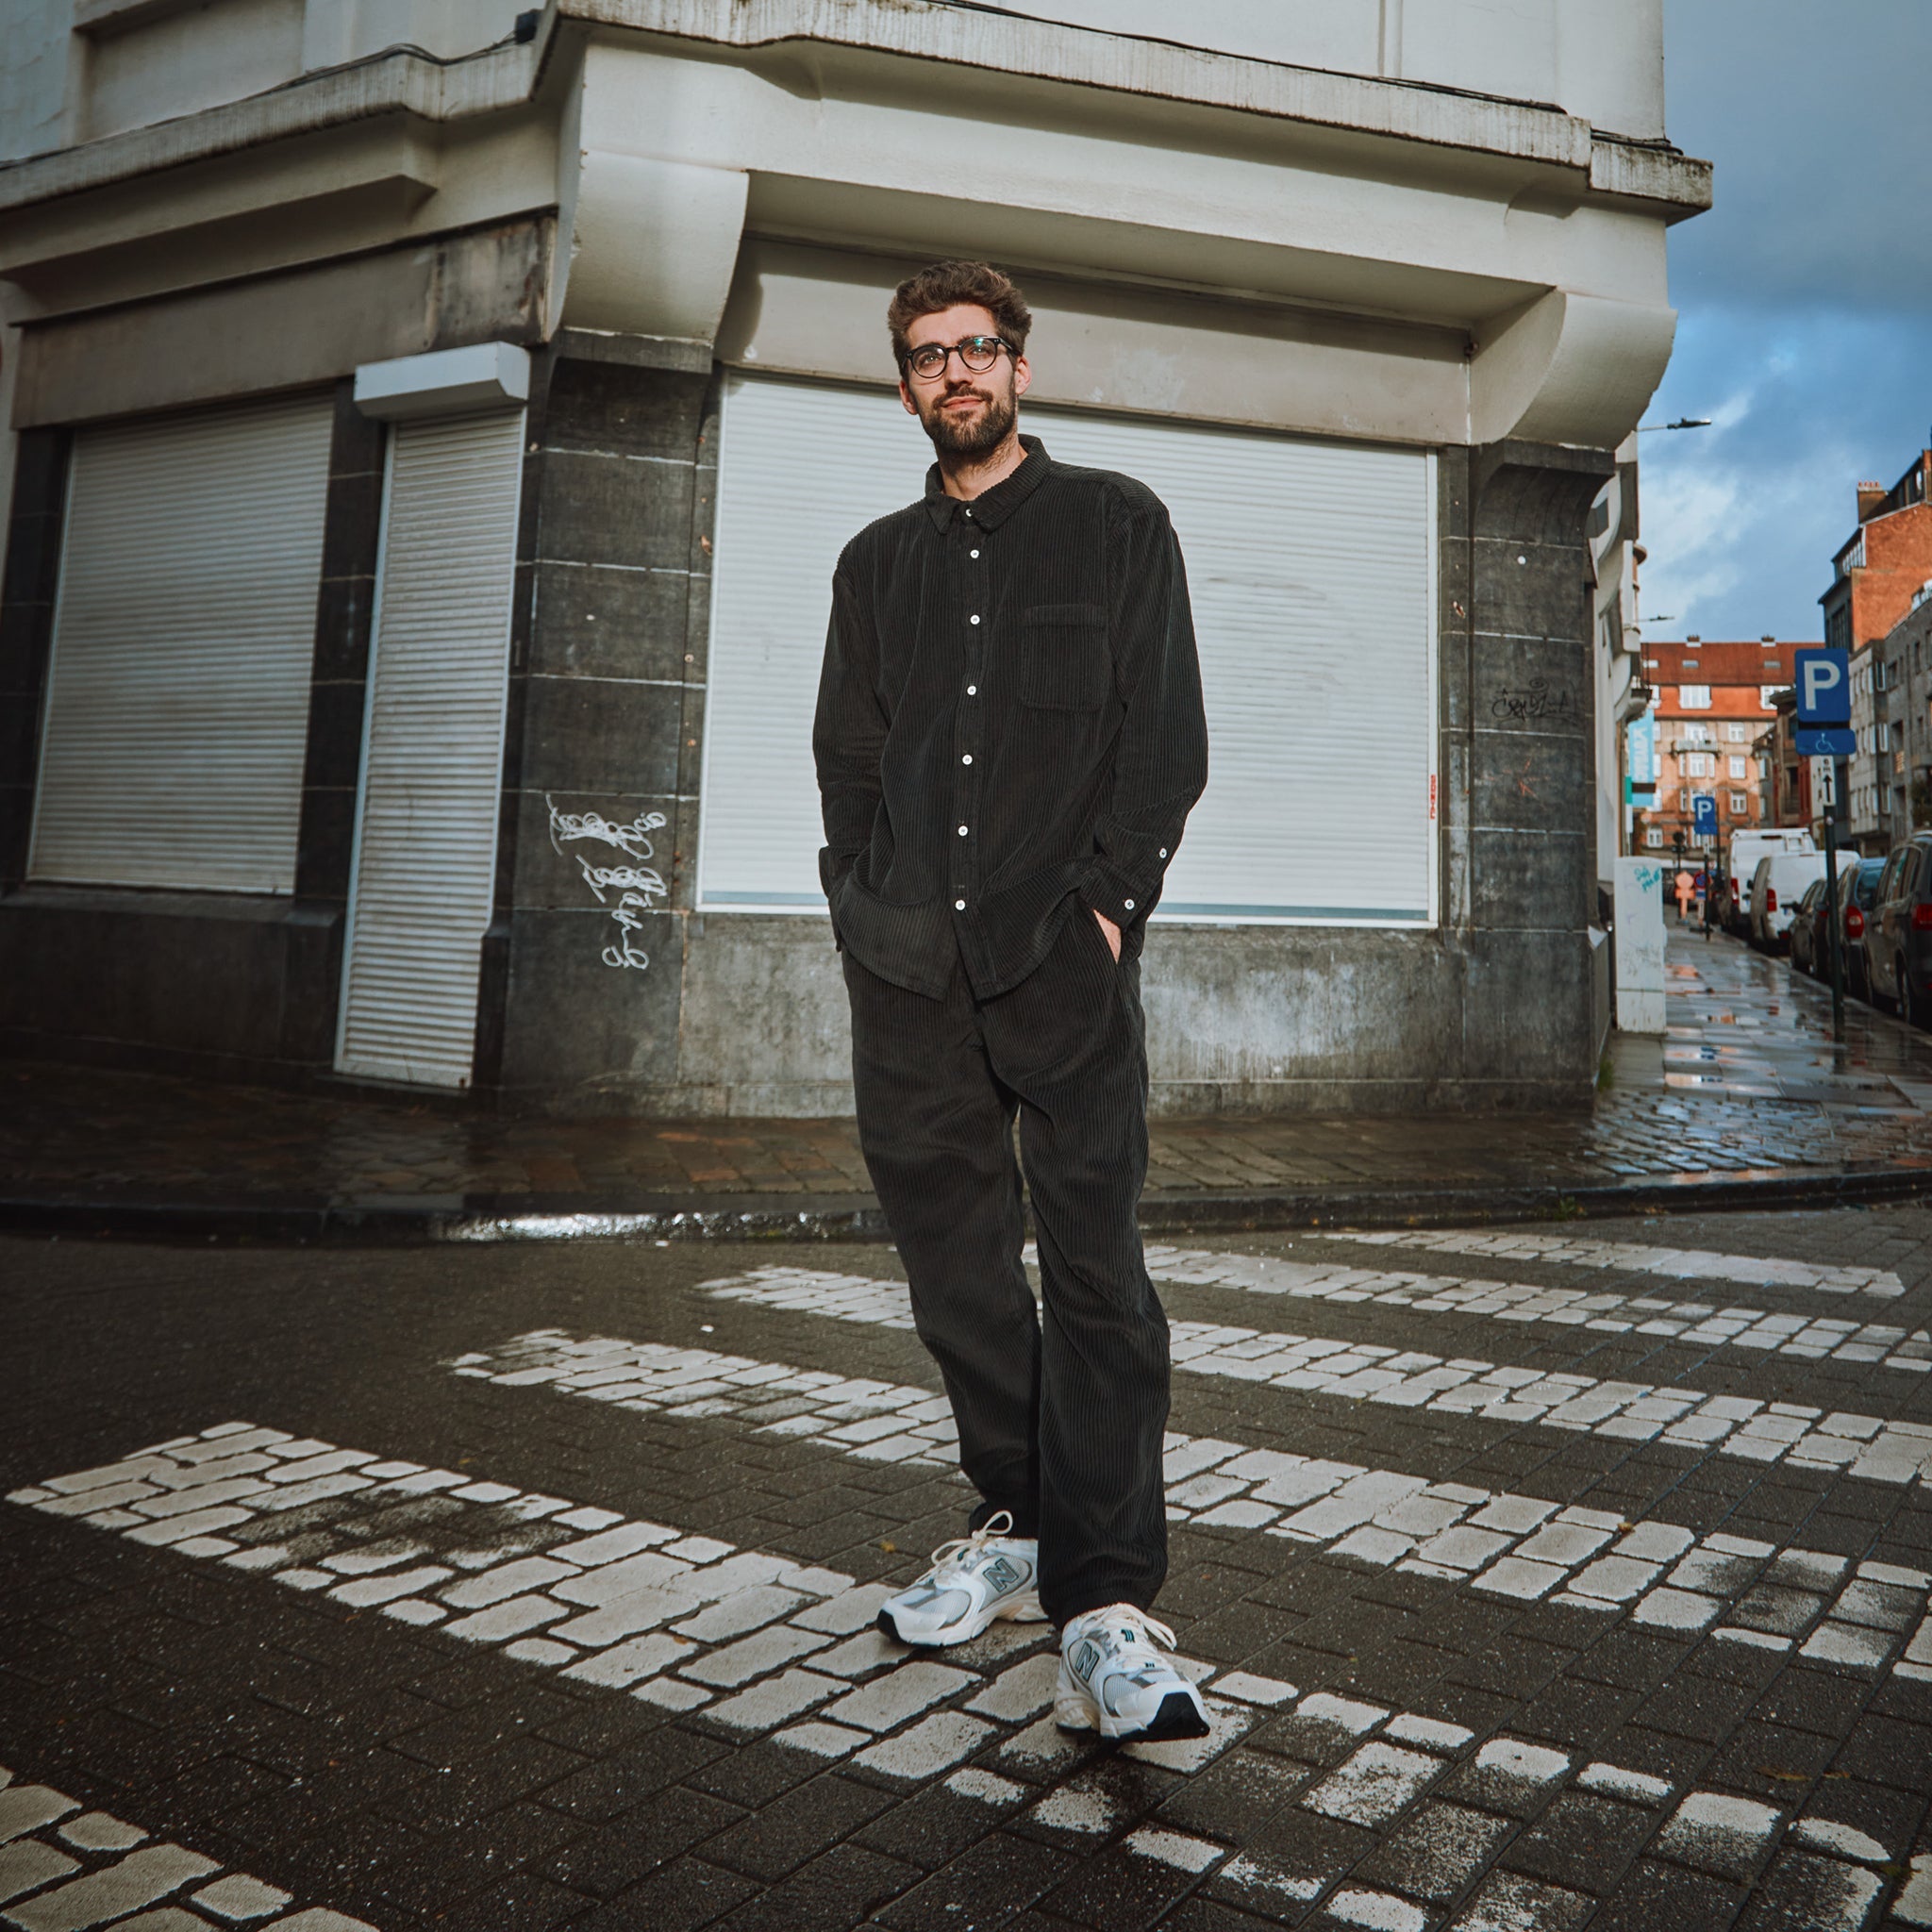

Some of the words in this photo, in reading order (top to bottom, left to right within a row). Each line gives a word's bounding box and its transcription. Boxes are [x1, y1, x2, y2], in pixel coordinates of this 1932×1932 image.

[1804, 660, 1840, 710] P
[1697, 800, 1712, 821] P
[982, 1557, 1019, 1592] N
[1075, 1641, 1099, 1682] N
